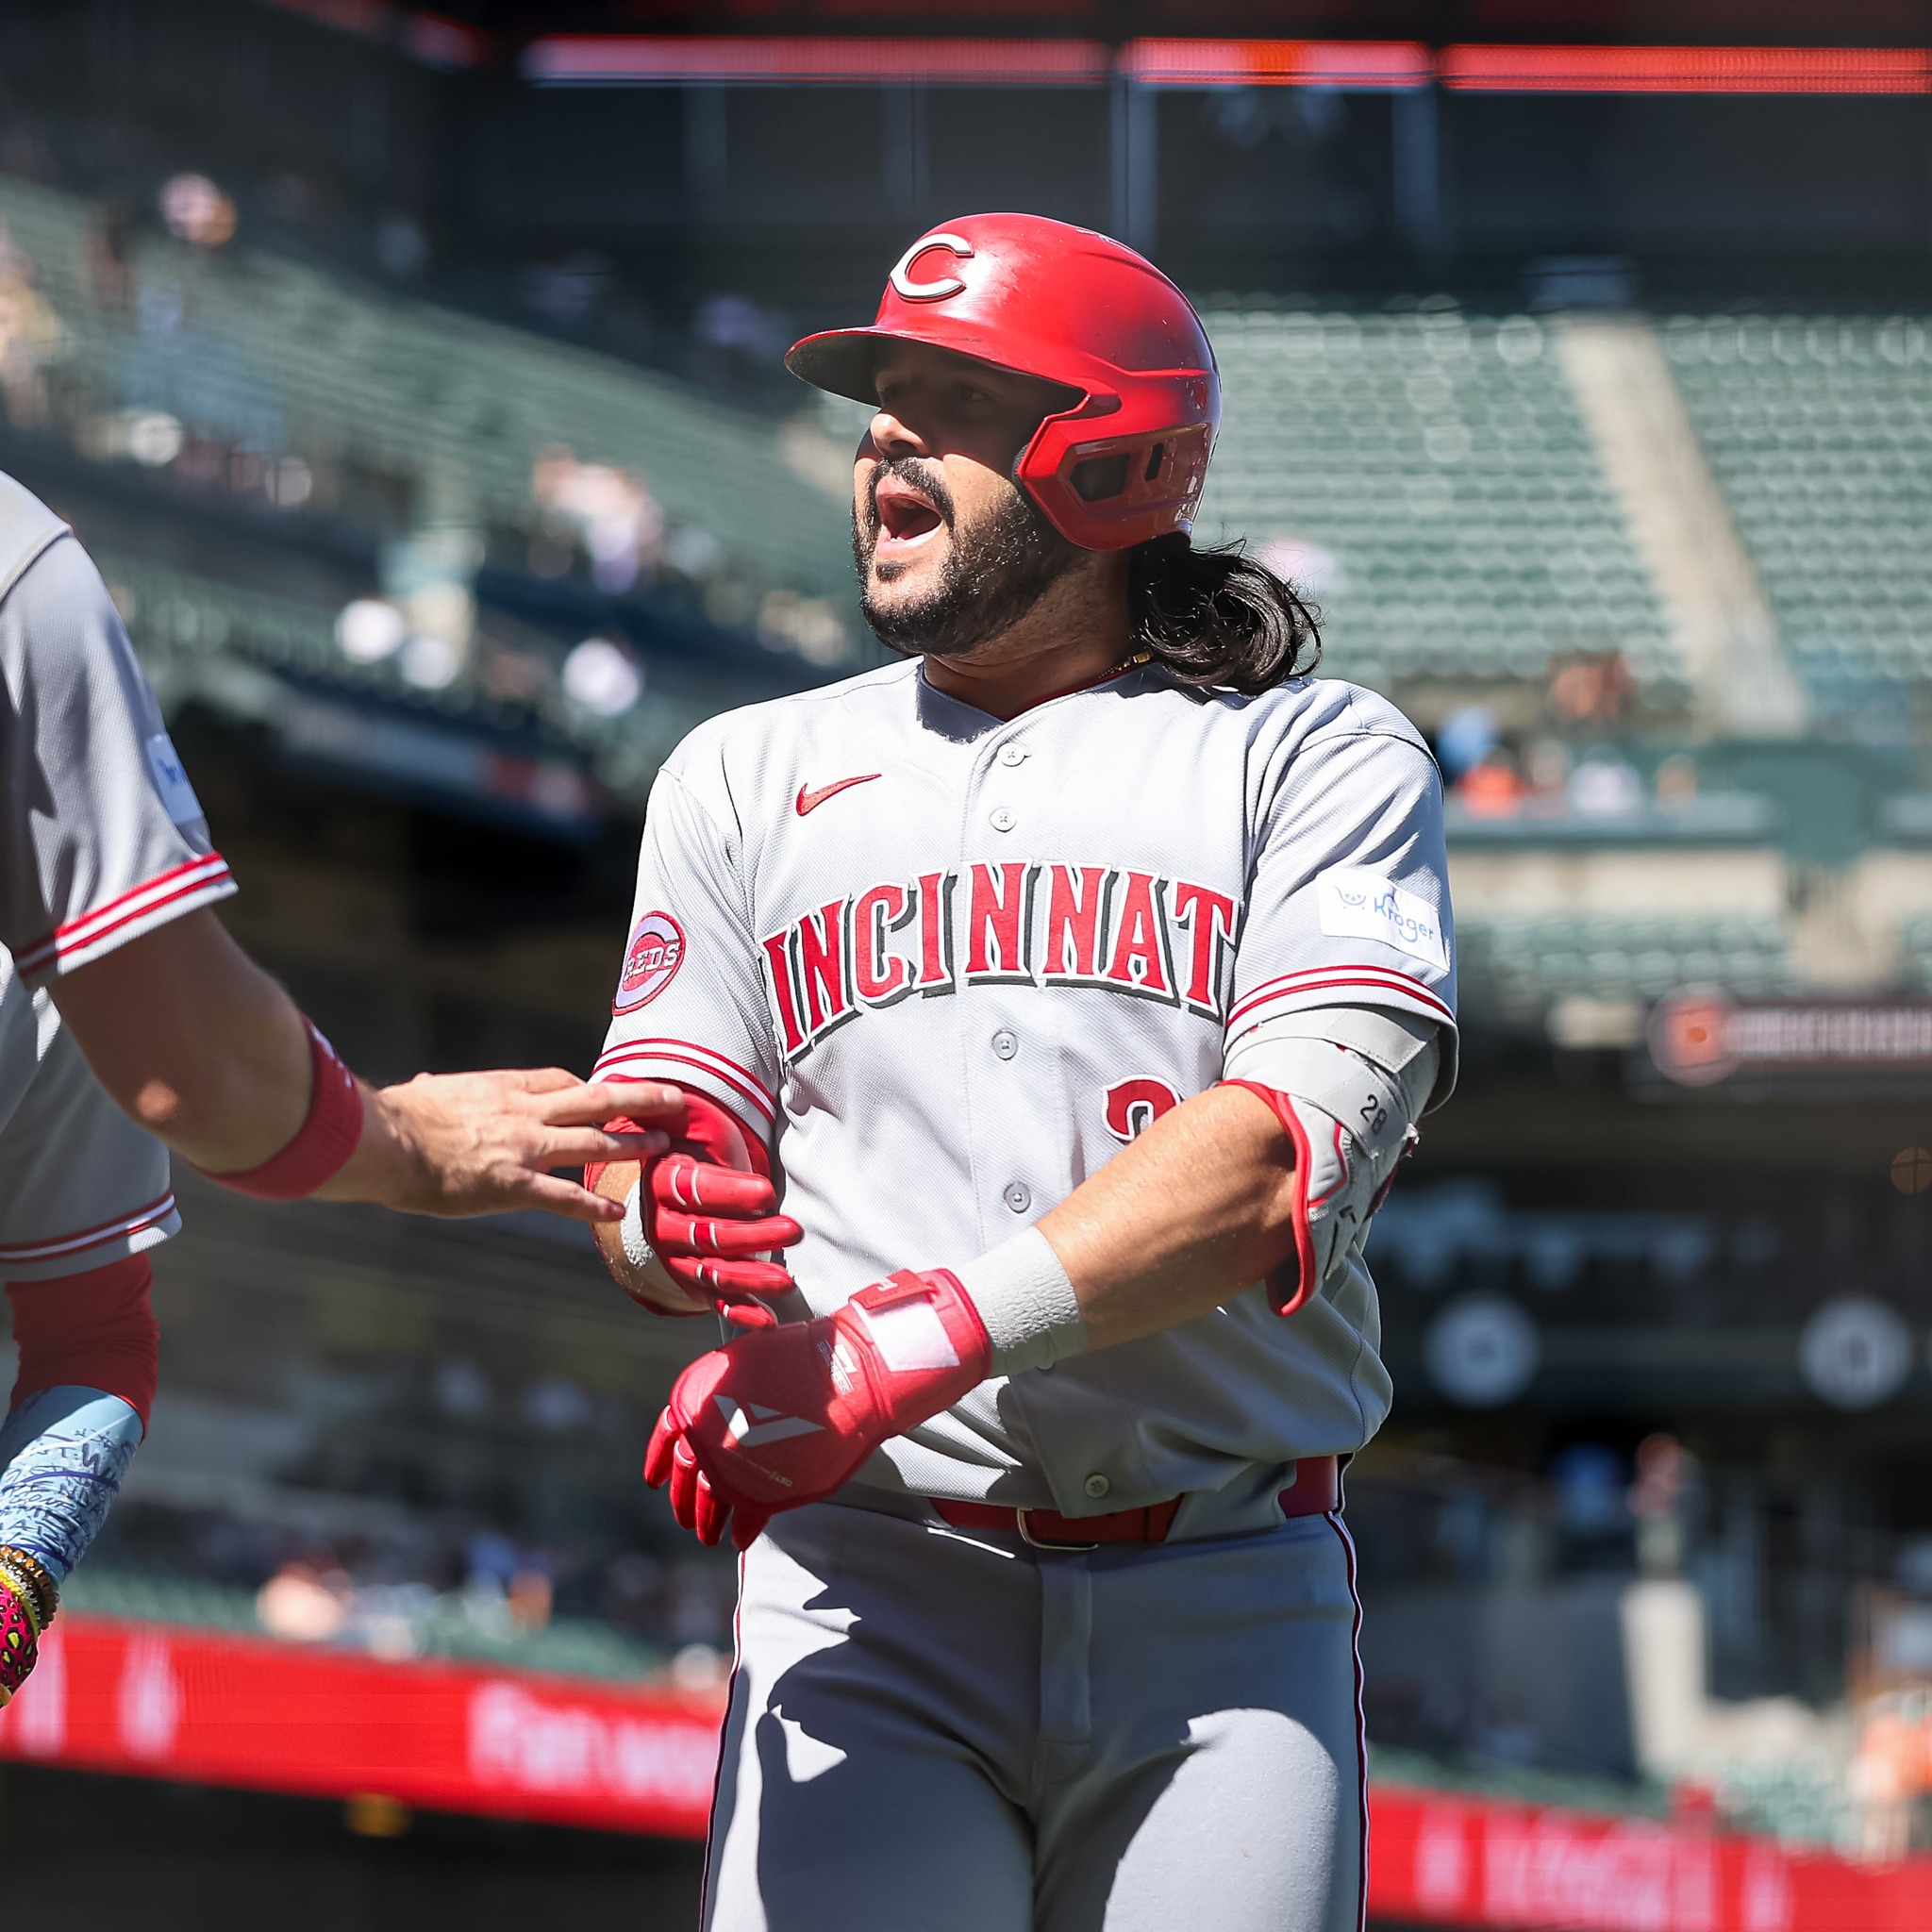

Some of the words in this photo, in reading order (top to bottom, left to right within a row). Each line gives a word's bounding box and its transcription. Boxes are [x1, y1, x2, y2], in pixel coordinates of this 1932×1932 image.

[890, 233, 974, 302] C
[1374, 889, 1434, 943] Kroger
[759, 858, 1244, 1062] INCINNAT
[1359, 1093, 1388, 1136] 28
